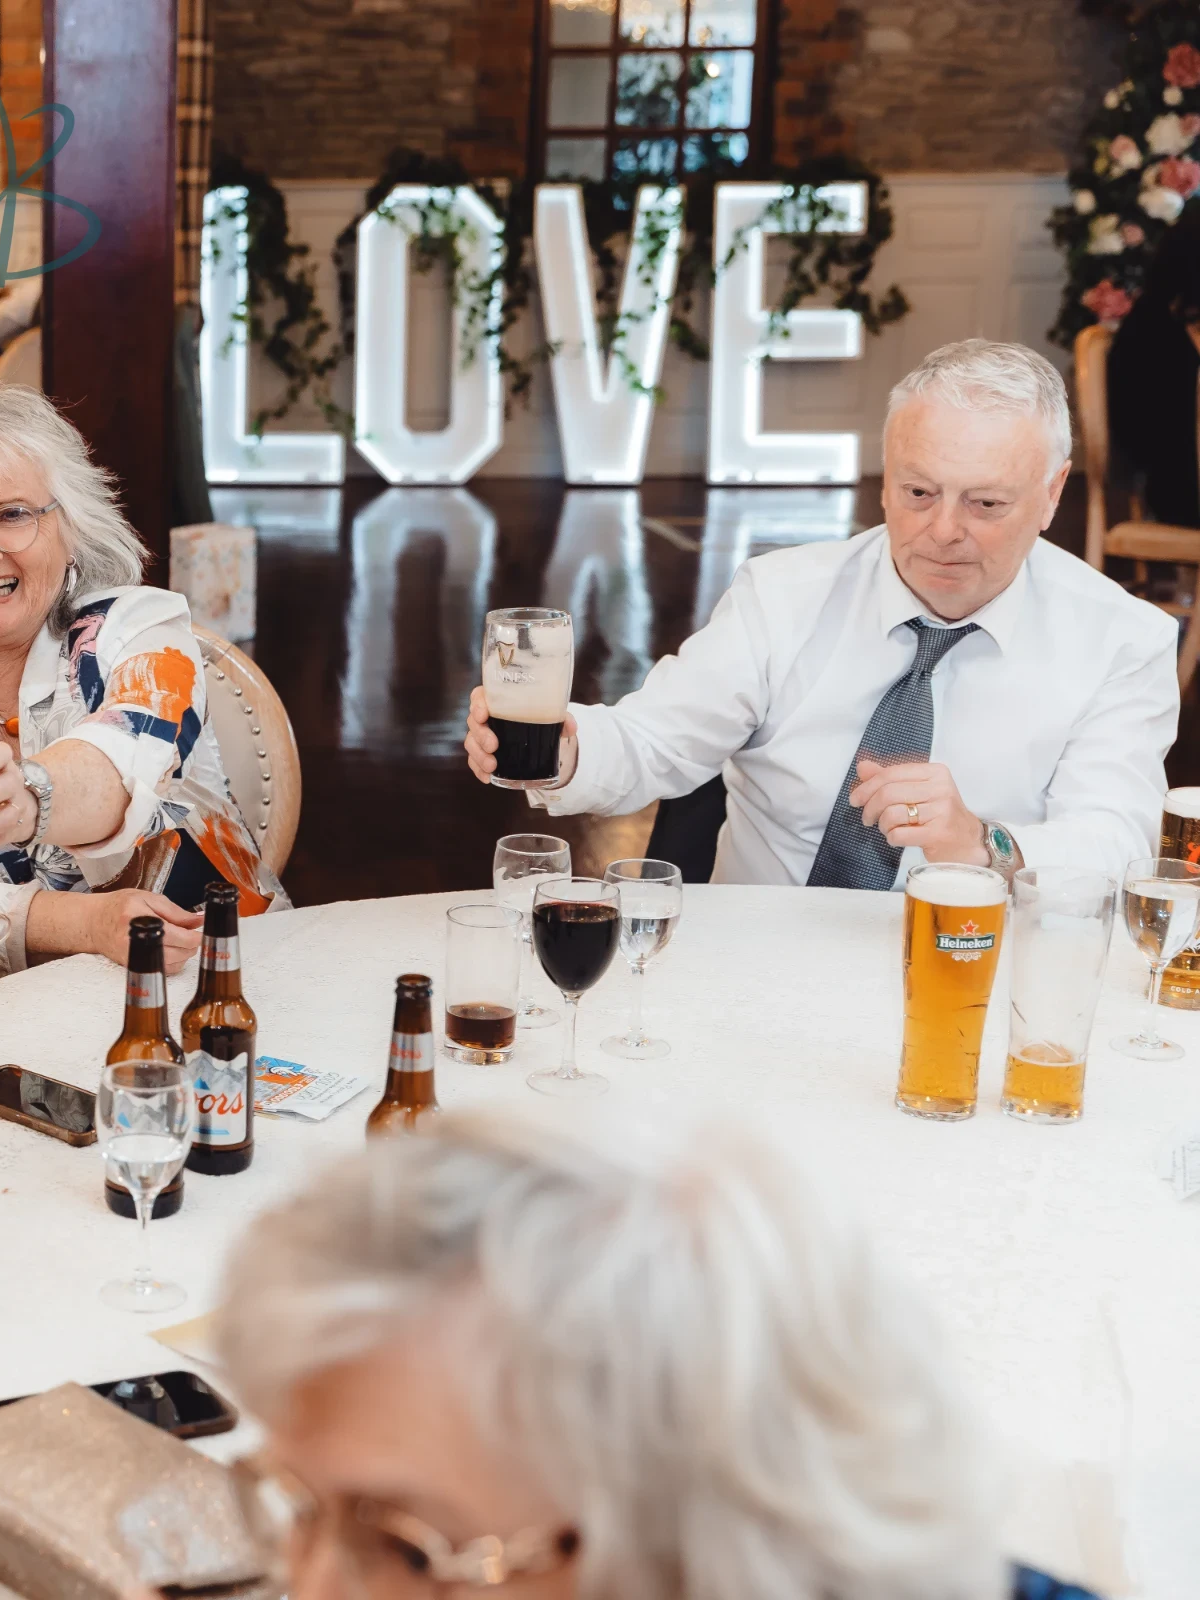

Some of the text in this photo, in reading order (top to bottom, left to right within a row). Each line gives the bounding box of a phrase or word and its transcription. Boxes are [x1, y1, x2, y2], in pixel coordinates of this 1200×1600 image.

[200, 183, 867, 485] LOVE
[491, 668, 536, 684] INNESS
[939, 937, 993, 949] Heineken
[180, 1088, 244, 1115] ors
